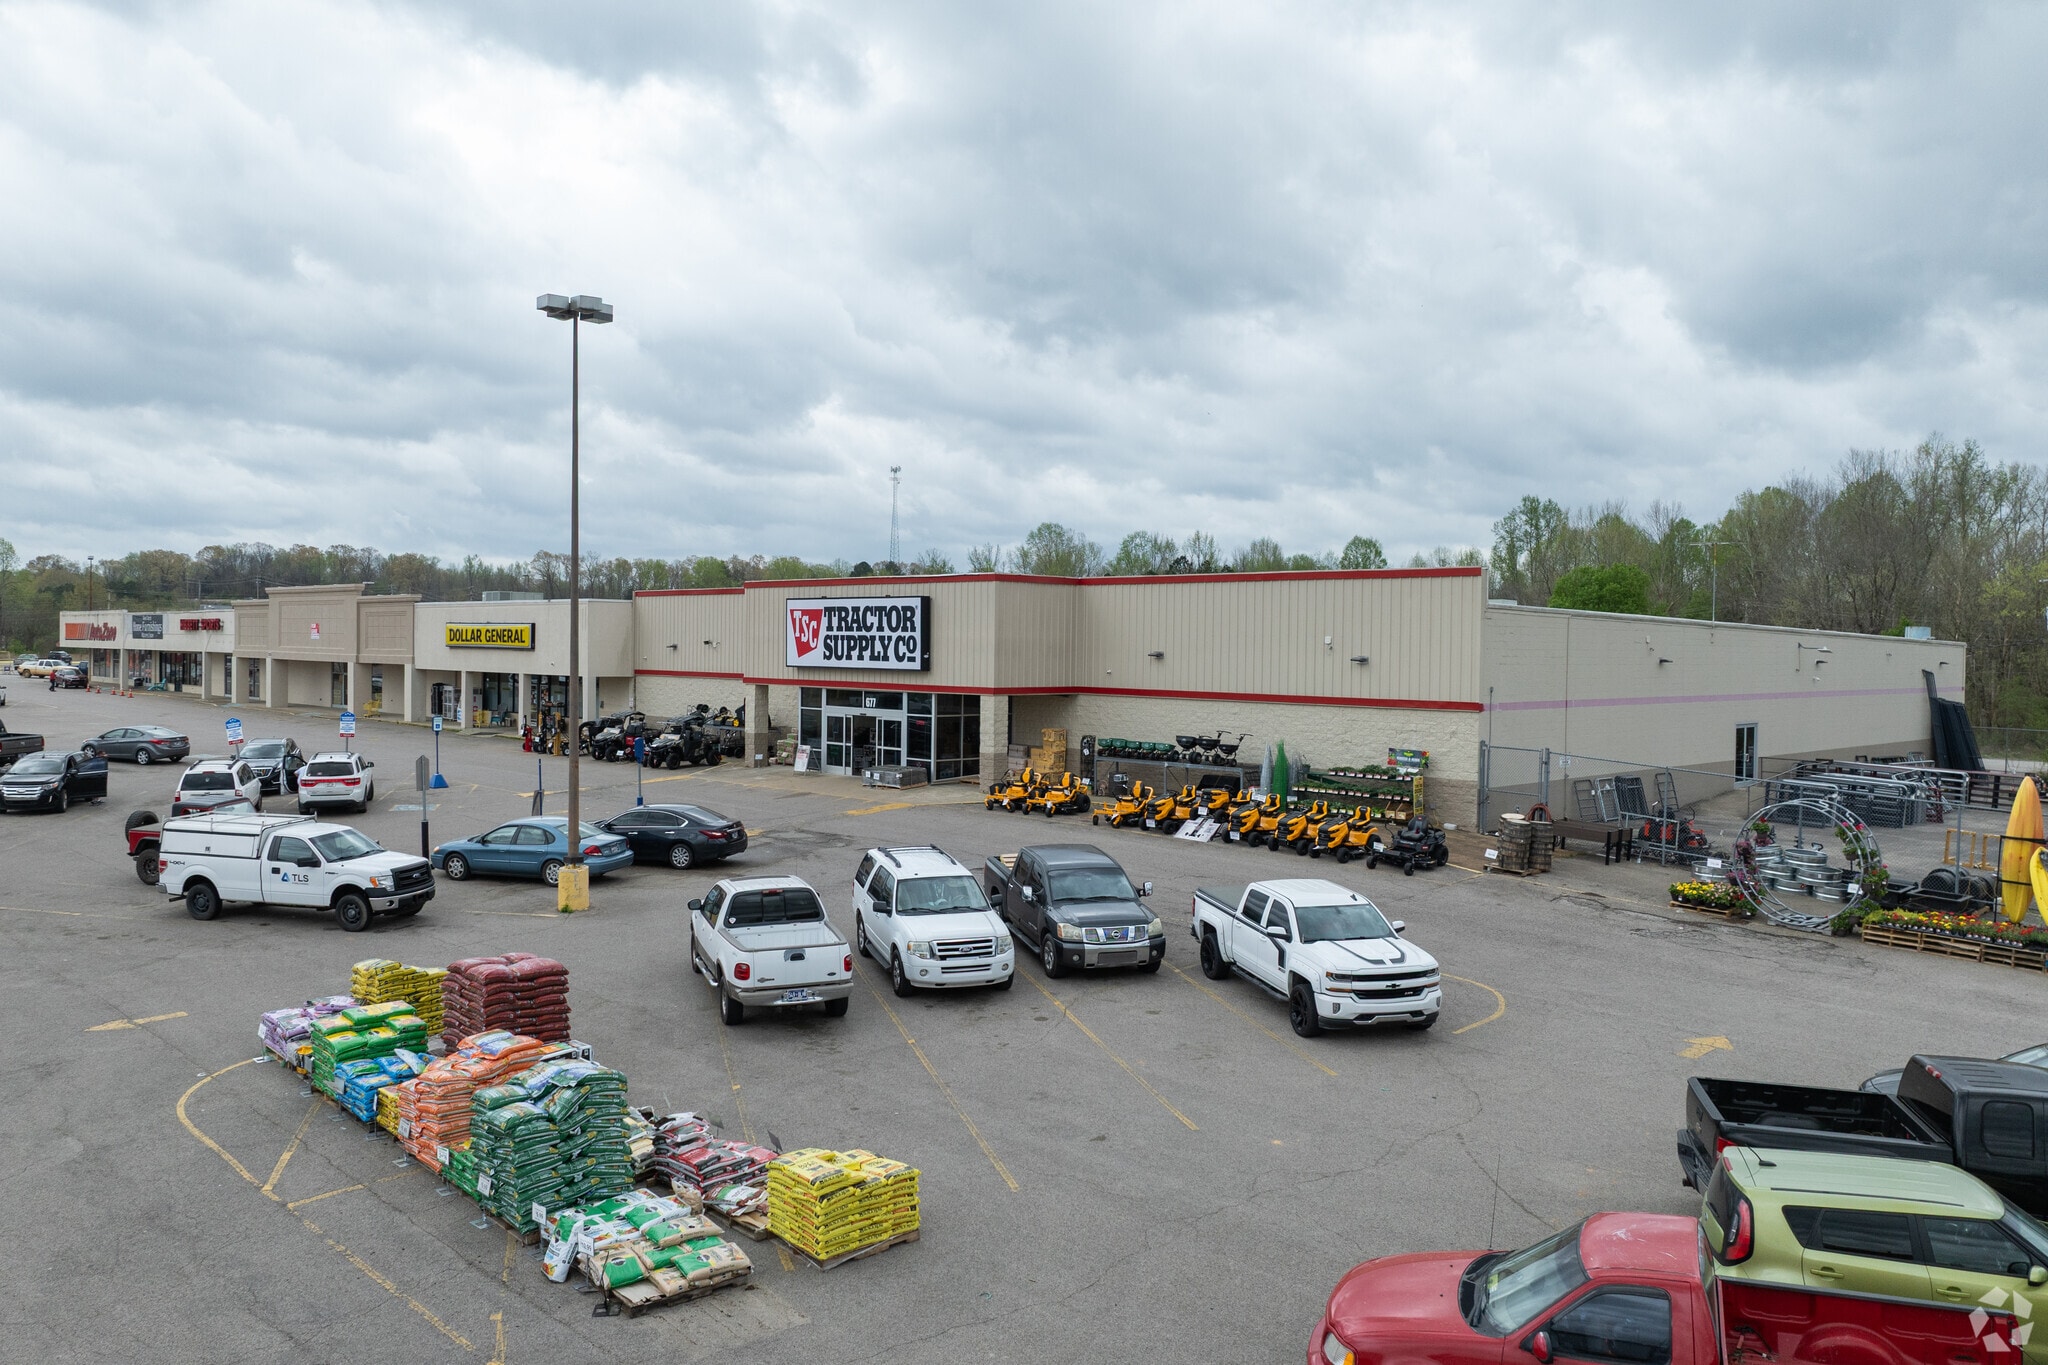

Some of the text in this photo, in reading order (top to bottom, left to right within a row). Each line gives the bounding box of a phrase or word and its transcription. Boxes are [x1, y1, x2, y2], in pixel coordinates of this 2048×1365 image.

[793, 610, 817, 648] TSC
[823, 605, 917, 633] TRACTOR
[449, 628, 526, 644] DOLLAR GENERAL
[823, 634, 892, 662] SUPPLY
[865, 697, 876, 708] 677
[291, 873, 309, 883] TLS
